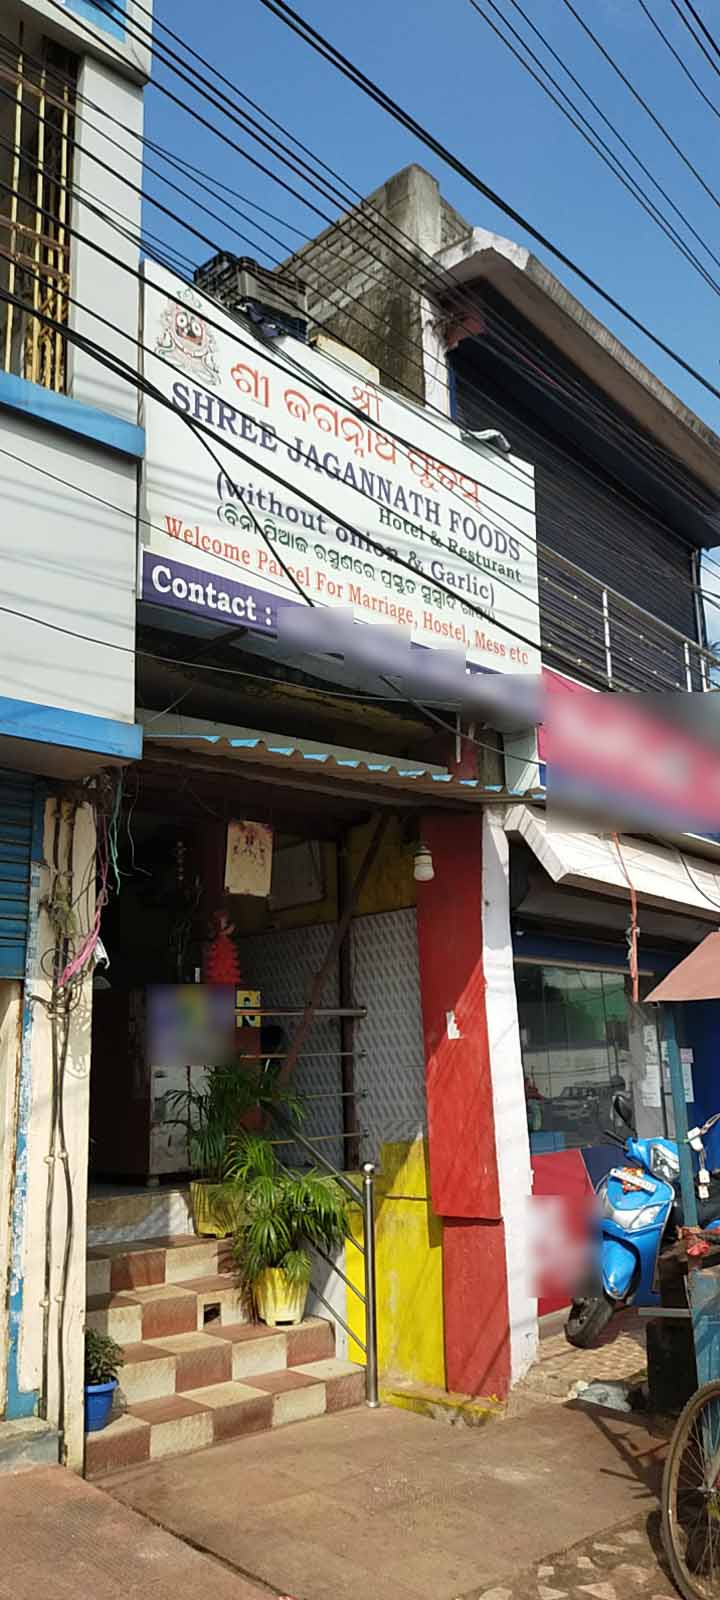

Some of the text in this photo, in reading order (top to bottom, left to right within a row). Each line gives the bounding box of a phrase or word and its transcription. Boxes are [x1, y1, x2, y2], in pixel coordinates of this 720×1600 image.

[351, 382, 383, 423] श्री
[172, 381, 522, 561] SHREE JAGANNATH FOODS
[151, 564, 257, 622] Contact
[164, 513, 529, 665] Welcome Parcel For Marriage, Hostel, Mess etc
[216, 470, 495, 609] (without onion & Garlic)
[378, 506, 523, 583] Hotel & Resturant
